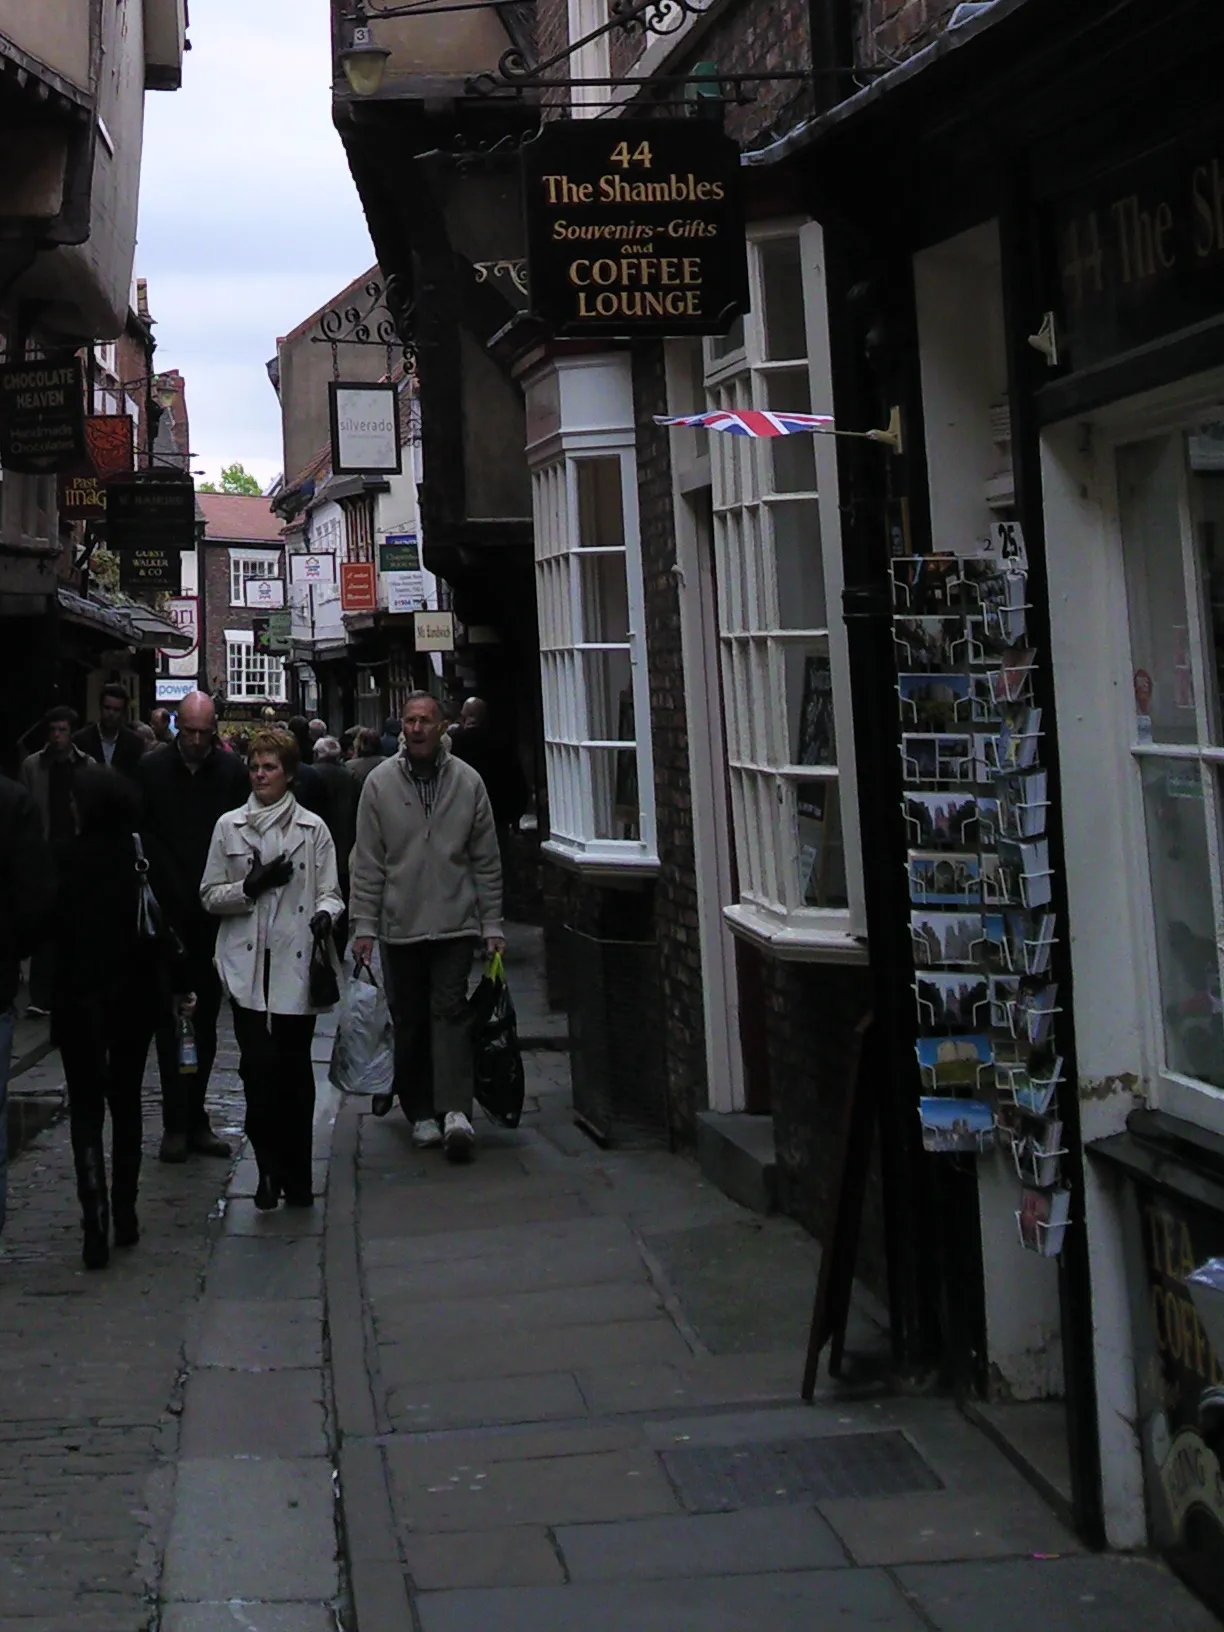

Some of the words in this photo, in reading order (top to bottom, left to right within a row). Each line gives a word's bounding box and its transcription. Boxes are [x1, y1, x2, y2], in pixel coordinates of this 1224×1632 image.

[610, 141, 652, 168] 44
[542, 175, 593, 204] The
[599, 174, 725, 202] Shambles
[620, 242, 653, 254] and
[1110, 192, 1176, 284] The
[569, 257, 703, 286] COFFEE
[578, 291, 703, 317] LOUNGE
[3, 368, 75, 391] CHOCOLATE
[16, 390, 65, 409] HEAVEN
[340, 418, 393, 432] silverado
[132, 559, 169, 568] WALKER
[139, 568, 146, 576] &
[159, 684, 193, 697] power
